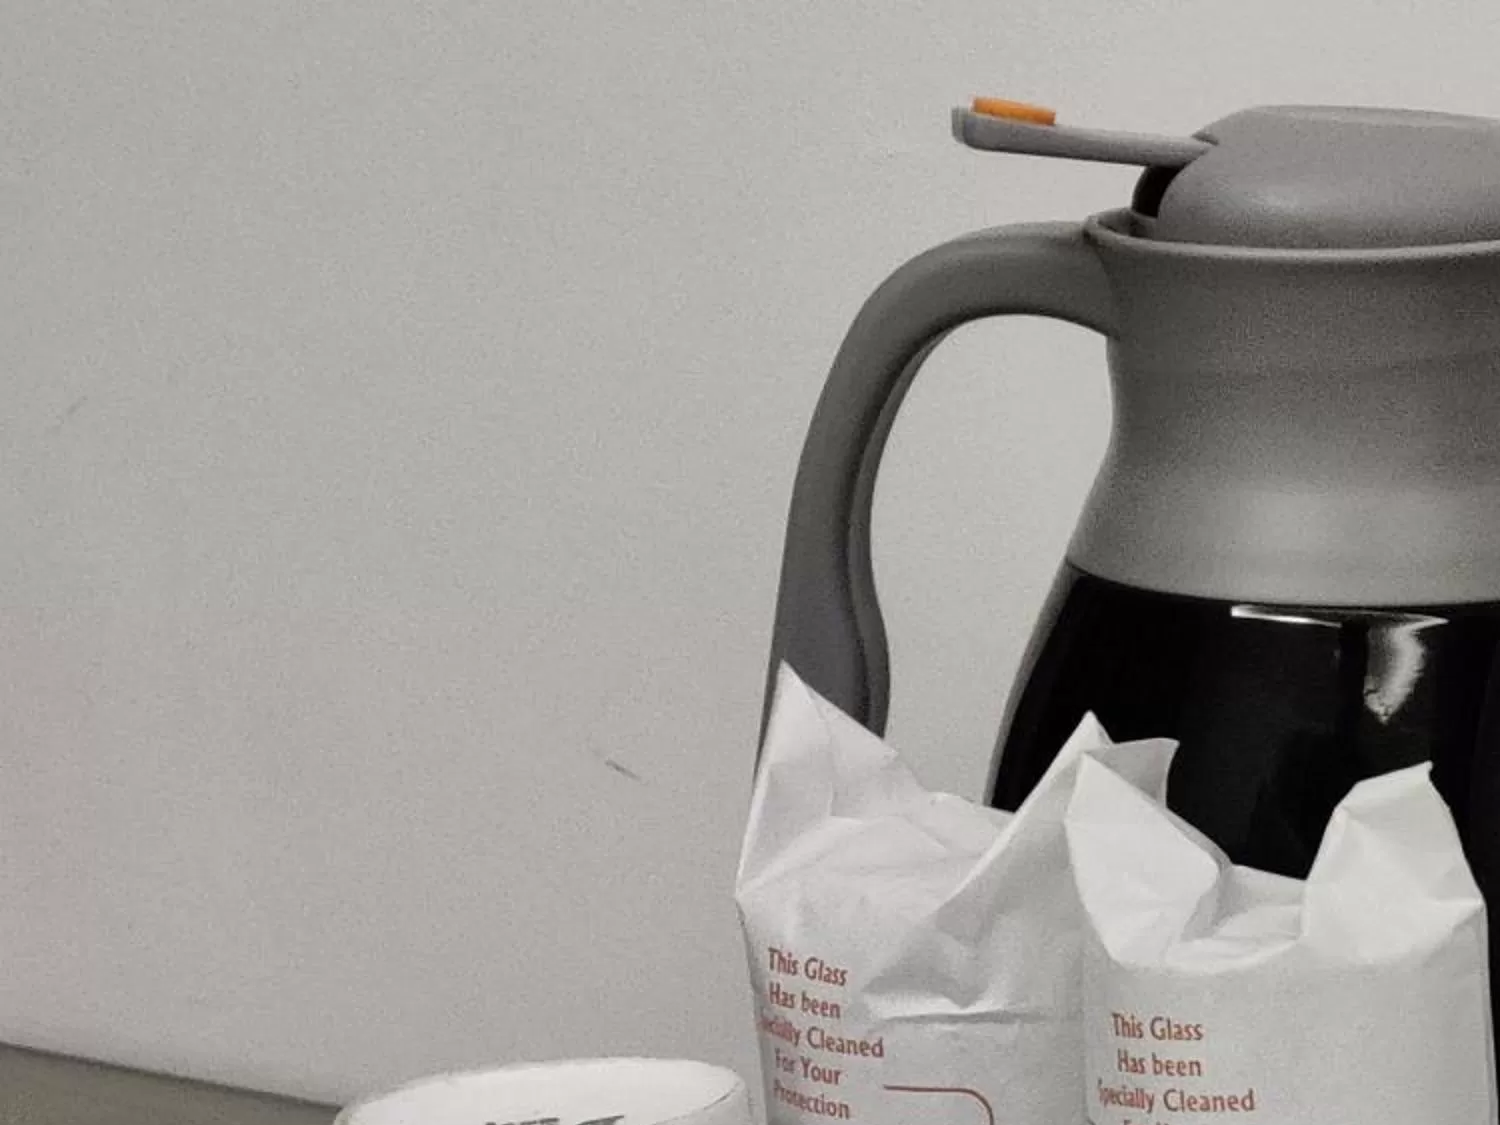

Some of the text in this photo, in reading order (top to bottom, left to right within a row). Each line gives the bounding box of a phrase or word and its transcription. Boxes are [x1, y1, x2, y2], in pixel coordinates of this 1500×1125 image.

[767, 947, 848, 987] This Glass
[769, 981, 841, 1018] Has been
[806, 1025, 885, 1058] Cleaned
[1112, 1012, 1204, 1041] This Glass
[800, 1055, 841, 1085] Your
[1117, 1048, 1202, 1077] Has been
[1163, 1088, 1256, 1113] Cleaned
